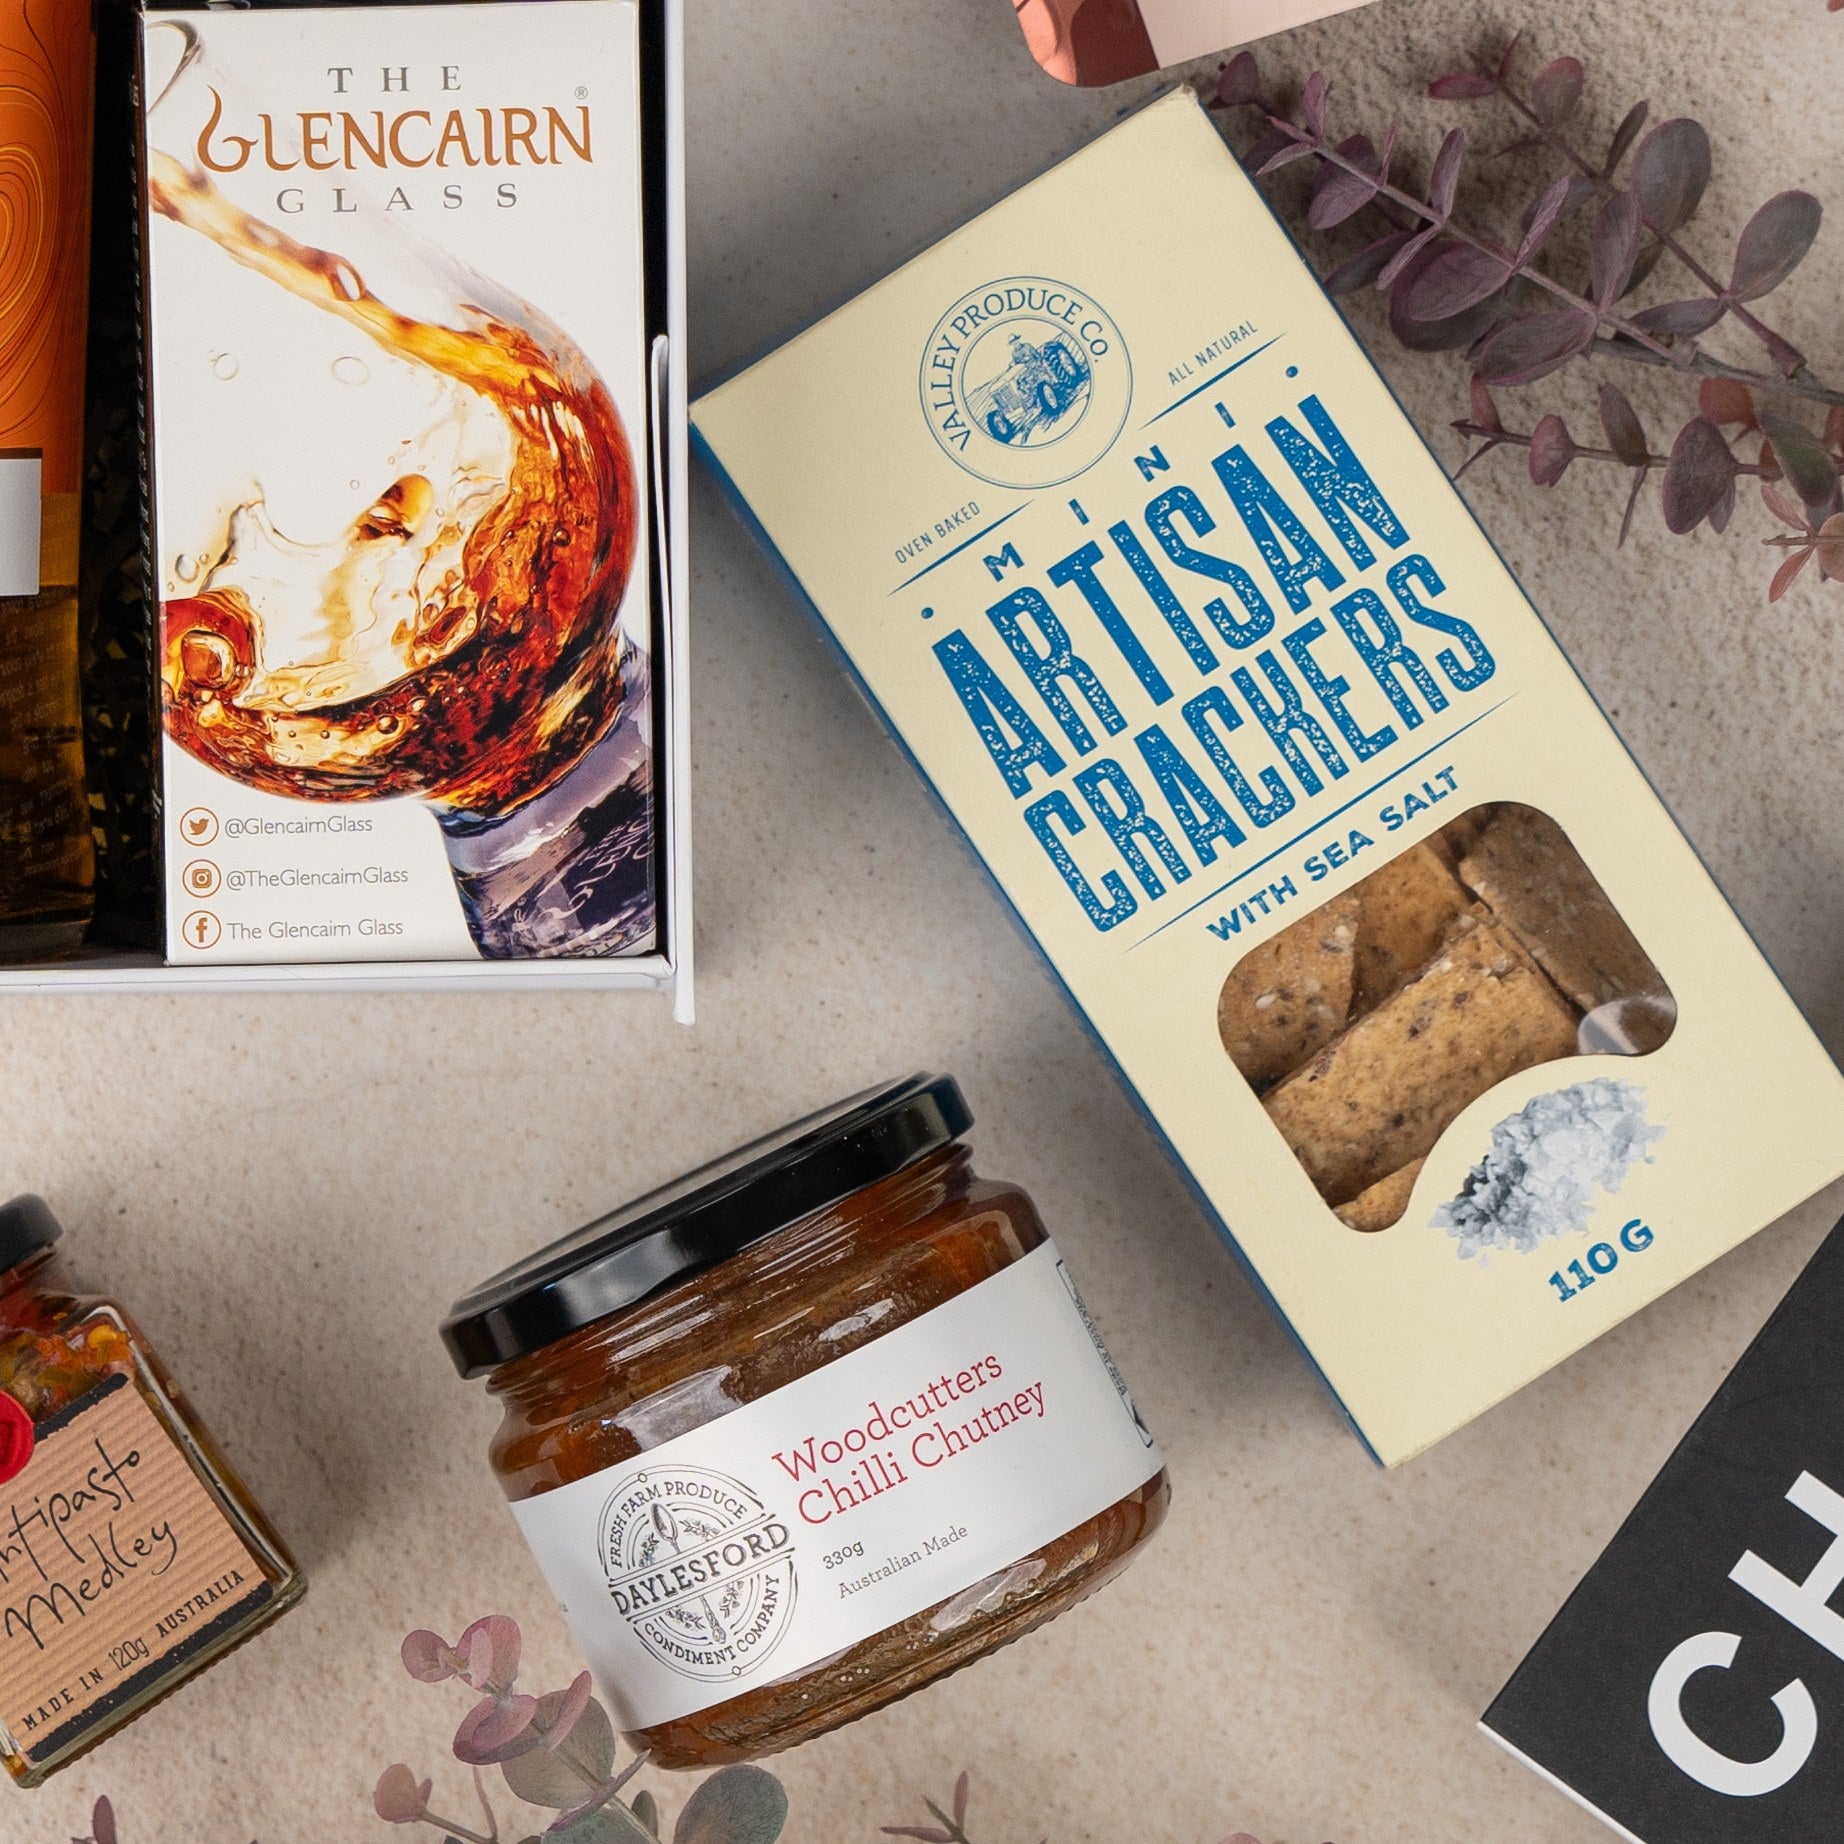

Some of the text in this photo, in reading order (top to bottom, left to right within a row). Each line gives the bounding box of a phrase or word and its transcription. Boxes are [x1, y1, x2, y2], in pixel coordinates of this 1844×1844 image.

[327, 65, 462, 93] THE
[197, 84, 593, 173] GLENCAIRN
[276, 183, 518, 213] GLASS
[930, 288, 1108, 451] VALLEY PRODUCE CO.
[1167, 320, 1258, 387] ALL NATURAL
[895, 501, 981, 564] OVEN BAKED
[931, 394, 1411, 800] ARTISAN
[1023, 553, 1496, 933] CRACKERS
[224, 815, 373, 838] @GlencairnGlass
[1205, 766, 1458, 942] WITH SEA SALT
[226, 866, 408, 891] @TheGlencairnGlass
[226, 918, 403, 939] The Glencairn Glass
[1547, 1218, 1655, 1302] 110 G
[771, 1355, 1002, 1482] Woodcutters
[798, 1381, 1046, 1524] Chilli Chutney
[0, 1438, 140, 1583] ntipasto
[610, 1481, 748, 1568] FRESH FARM PRODUCE
[4, 1520, 178, 1650] Medley
[611, 1523, 790, 1615] DAYLESFORD
[822, 1541, 865, 1570] 330g
[838, 1525, 968, 1598] Australian Made
[22, 1569, 245, 1731] MADE IN 120g AUSTRALIA
[644, 1574, 780, 1665] CONDIMENT COMPANY
